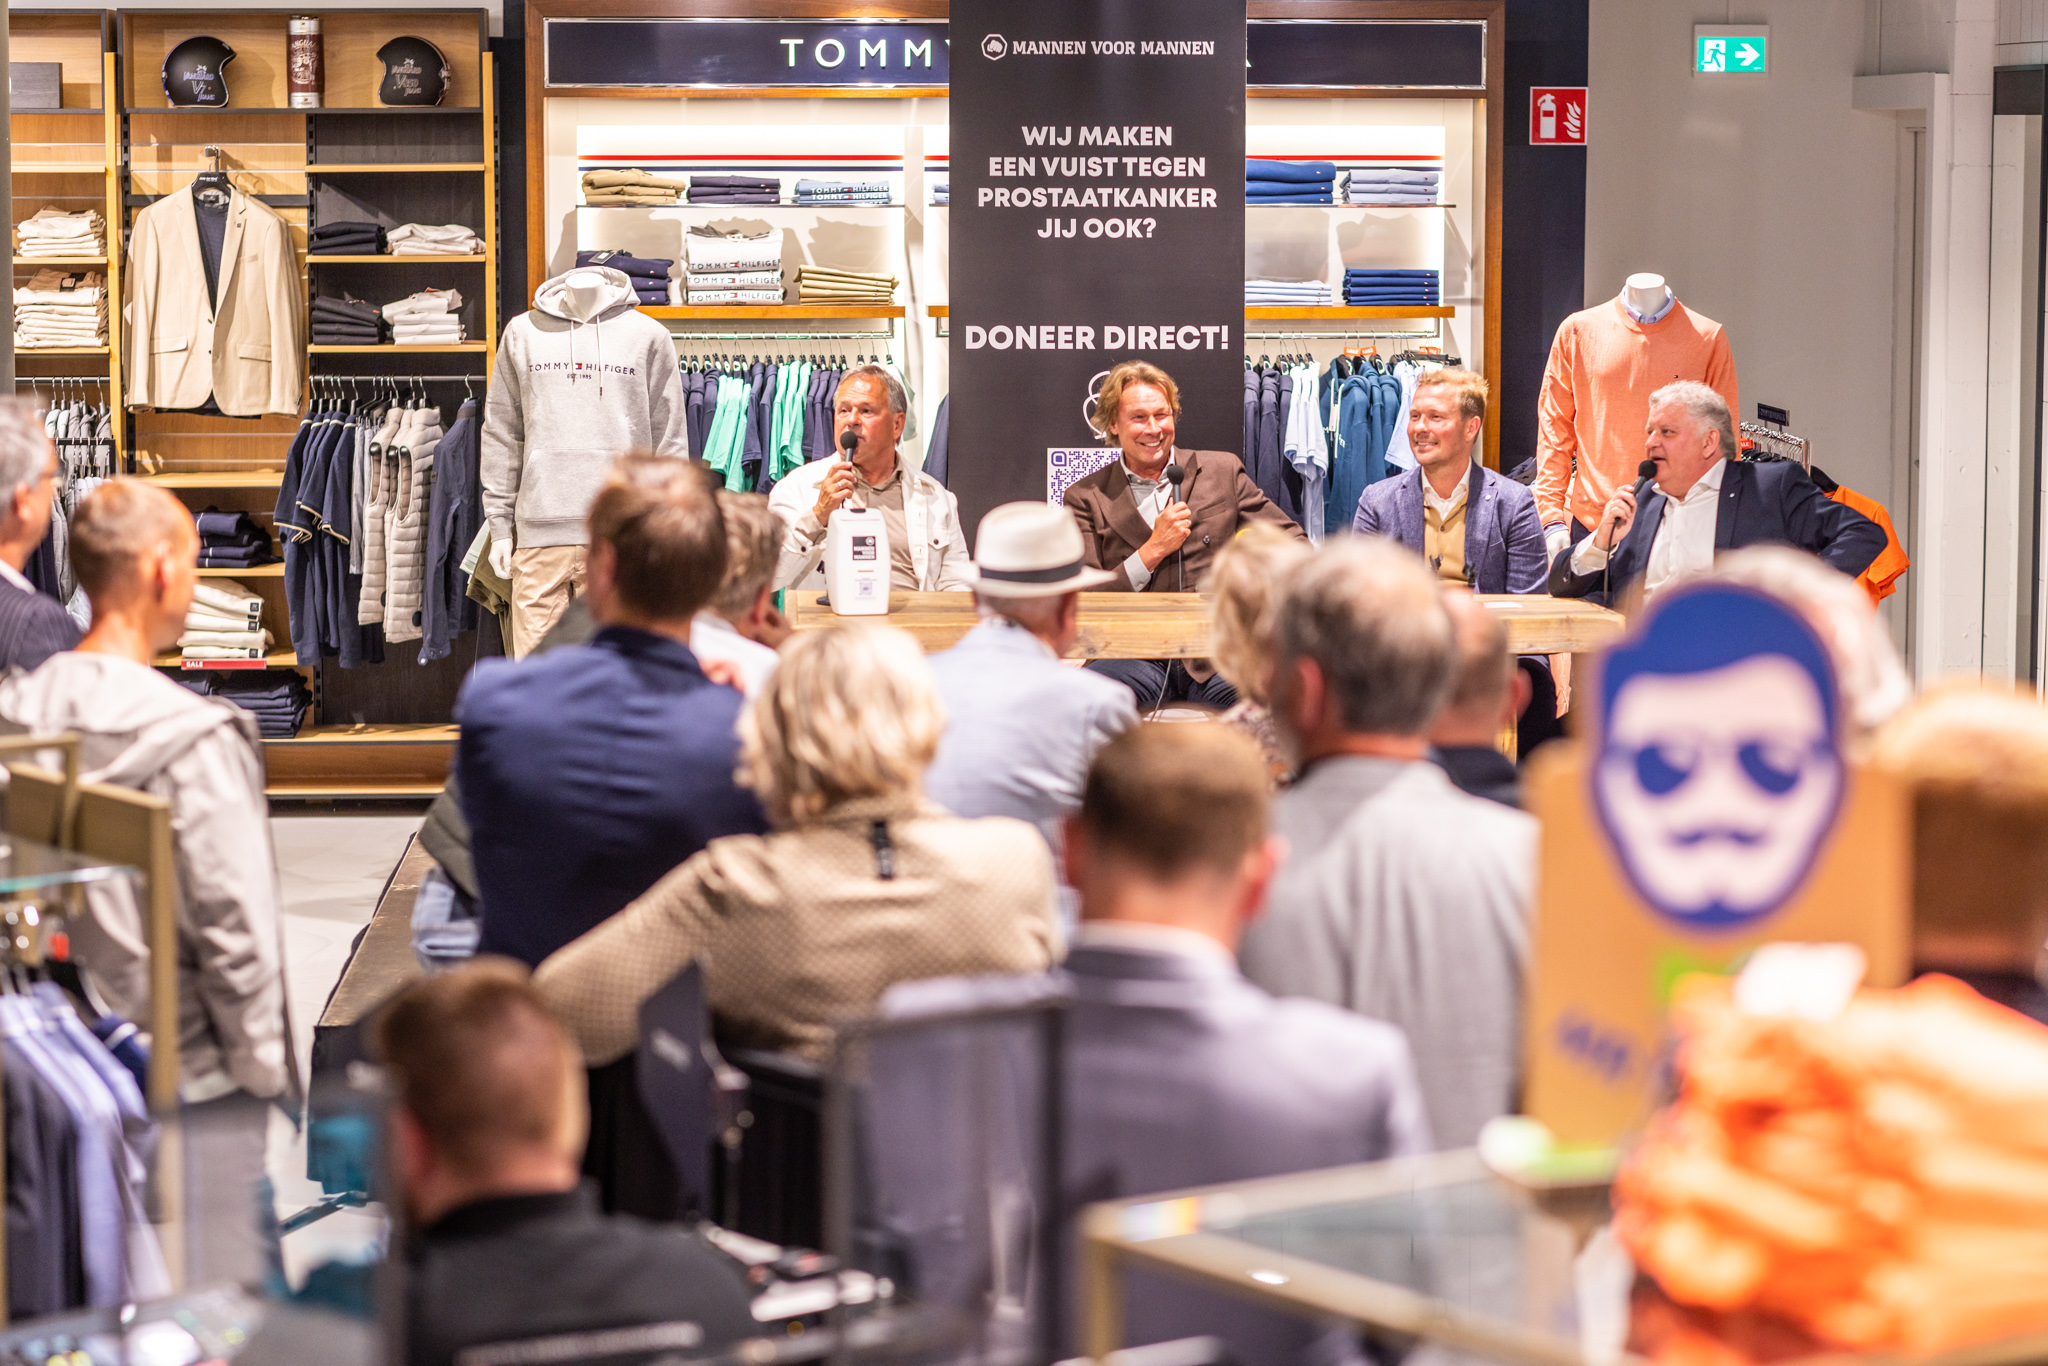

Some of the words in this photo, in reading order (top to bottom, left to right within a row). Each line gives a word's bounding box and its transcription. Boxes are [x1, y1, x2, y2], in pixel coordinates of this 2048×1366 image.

[779, 38, 950, 68] TOMM
[1012, 41, 1086, 55] MANNEN
[1091, 41, 1136, 55] VOOR
[1140, 41, 1215, 55] MANNEN
[1022, 126, 1072, 146] WIJ
[1078, 126, 1173, 146] MAKEN
[989, 157, 1036, 177] EEN
[1041, 157, 1119, 177] VUIST
[1122, 157, 1206, 177] TEGEN
[978, 187, 1218, 208] PROSTAATKANKER
[1037, 218, 1077, 238] JIJ
[1083, 218, 1157, 238] OOK?
[691, 262, 728, 270] TOMMY
[691, 293, 727, 302] TOMMY
[965, 325, 1096, 350] DONEER
[1103, 325, 1229, 350] DIRECT!
[529, 362, 570, 372] TOMMY
